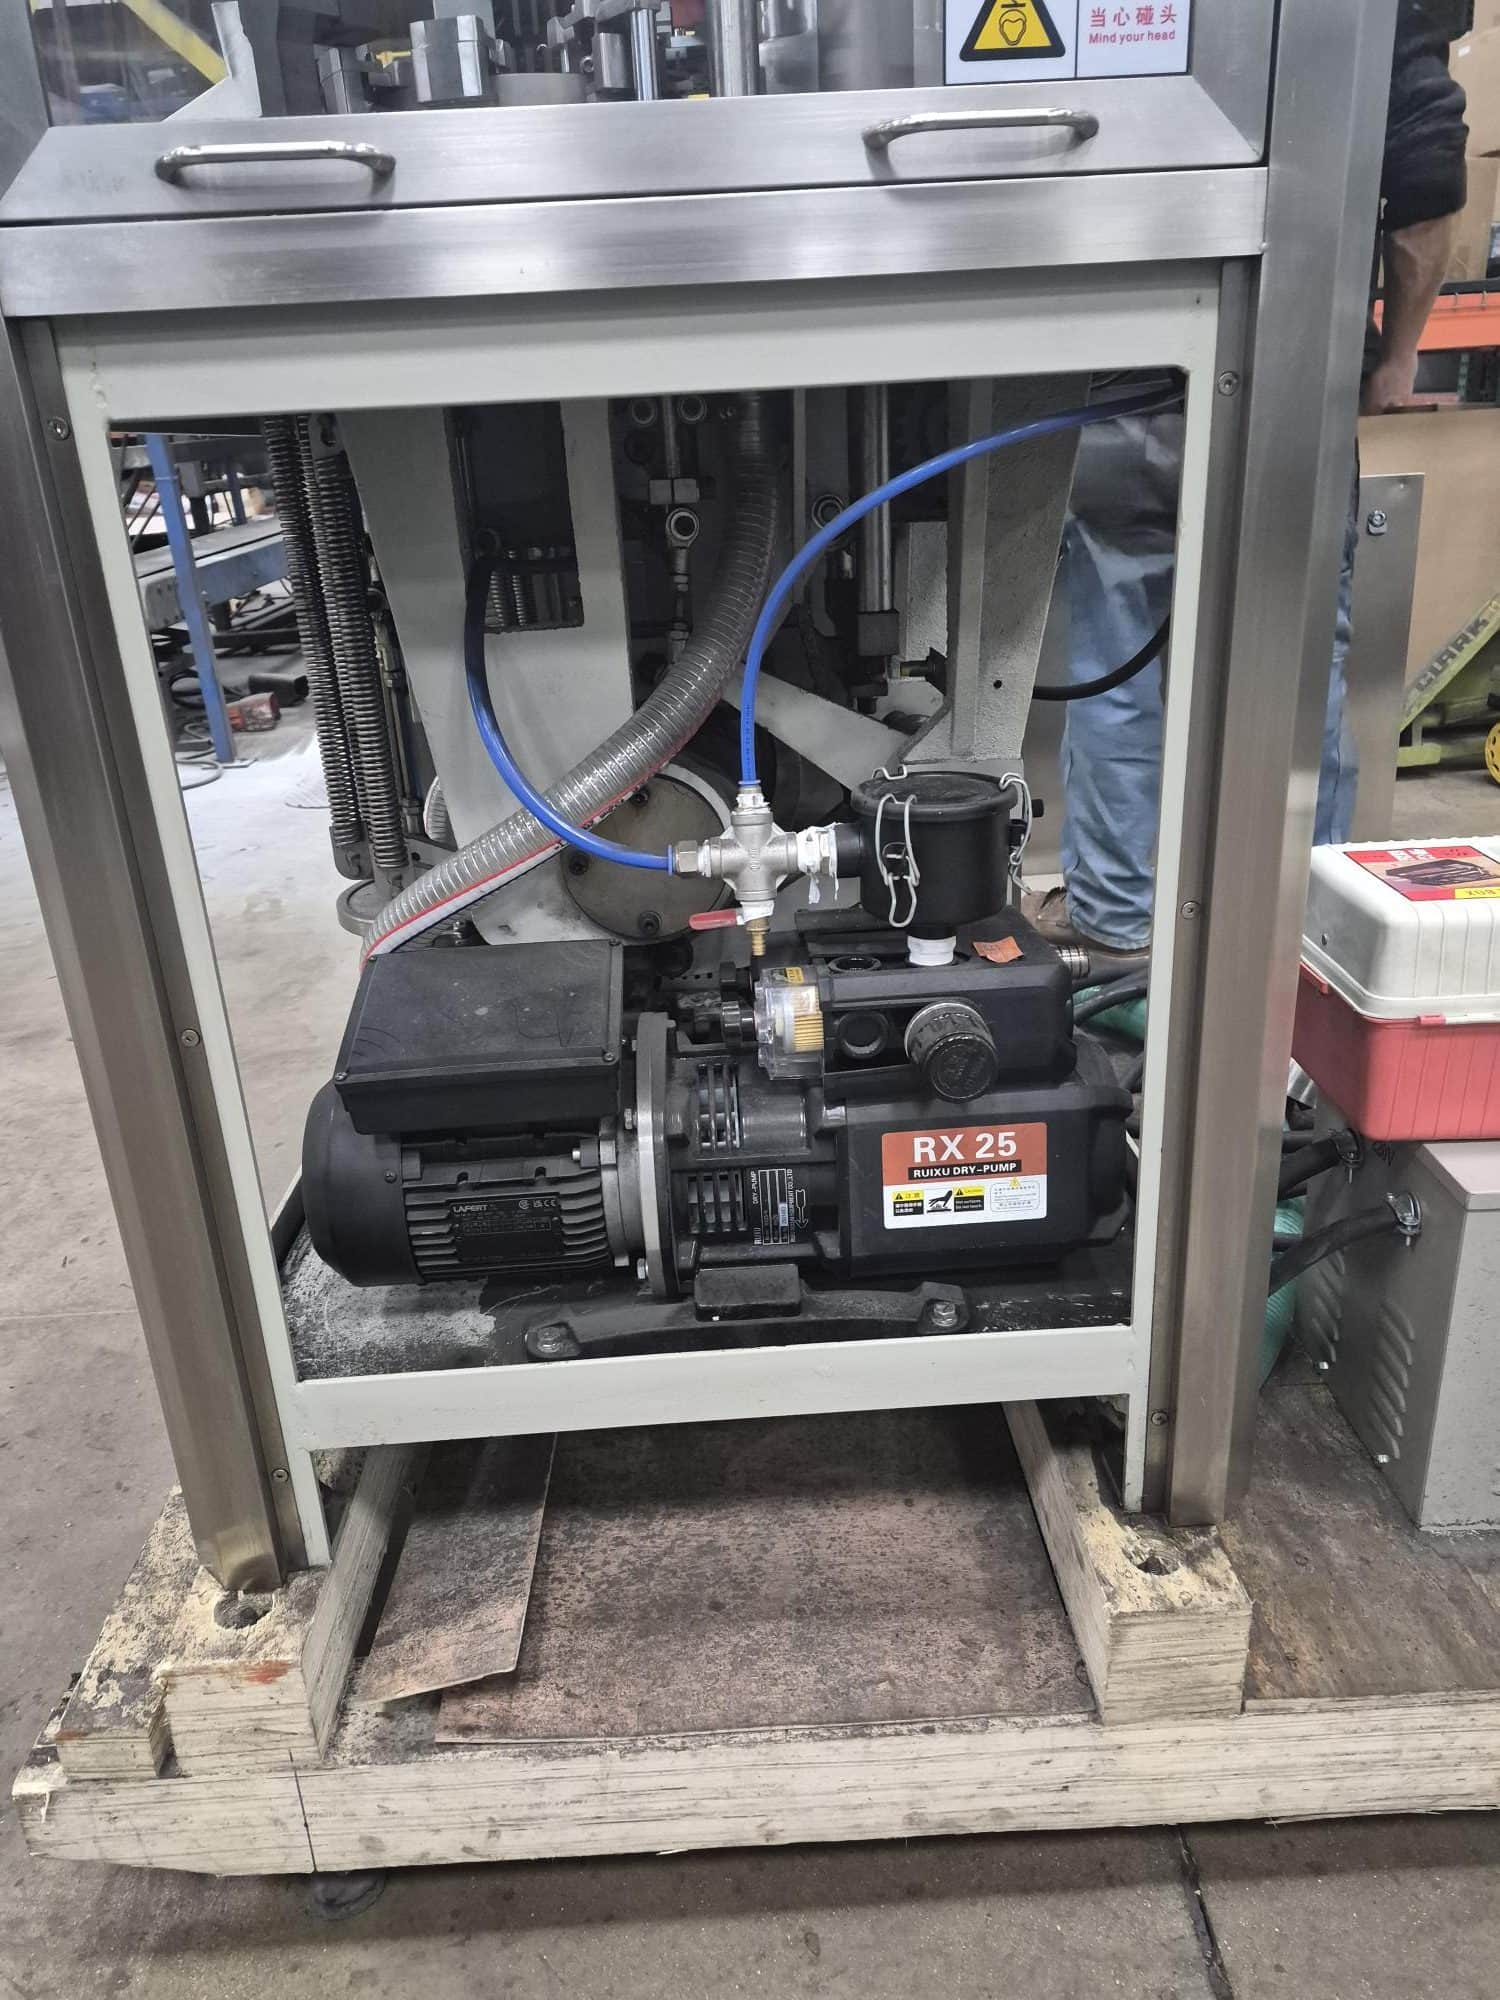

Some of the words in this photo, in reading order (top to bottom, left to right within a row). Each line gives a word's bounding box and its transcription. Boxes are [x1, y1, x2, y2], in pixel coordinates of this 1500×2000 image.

[1090, 5, 1178, 28] 当心碰头
[1088, 33, 1117, 44] Mind
[1118, 32, 1145, 44] your
[1147, 29, 1176, 42] head
[1416, 617, 1489, 692] CLARK
[913, 1134, 965, 1163] RX
[975, 1131, 1017, 1159] 25
[913, 1167, 950, 1178] RUIXU
[952, 1162, 1017, 1176] DRY-PUMP
